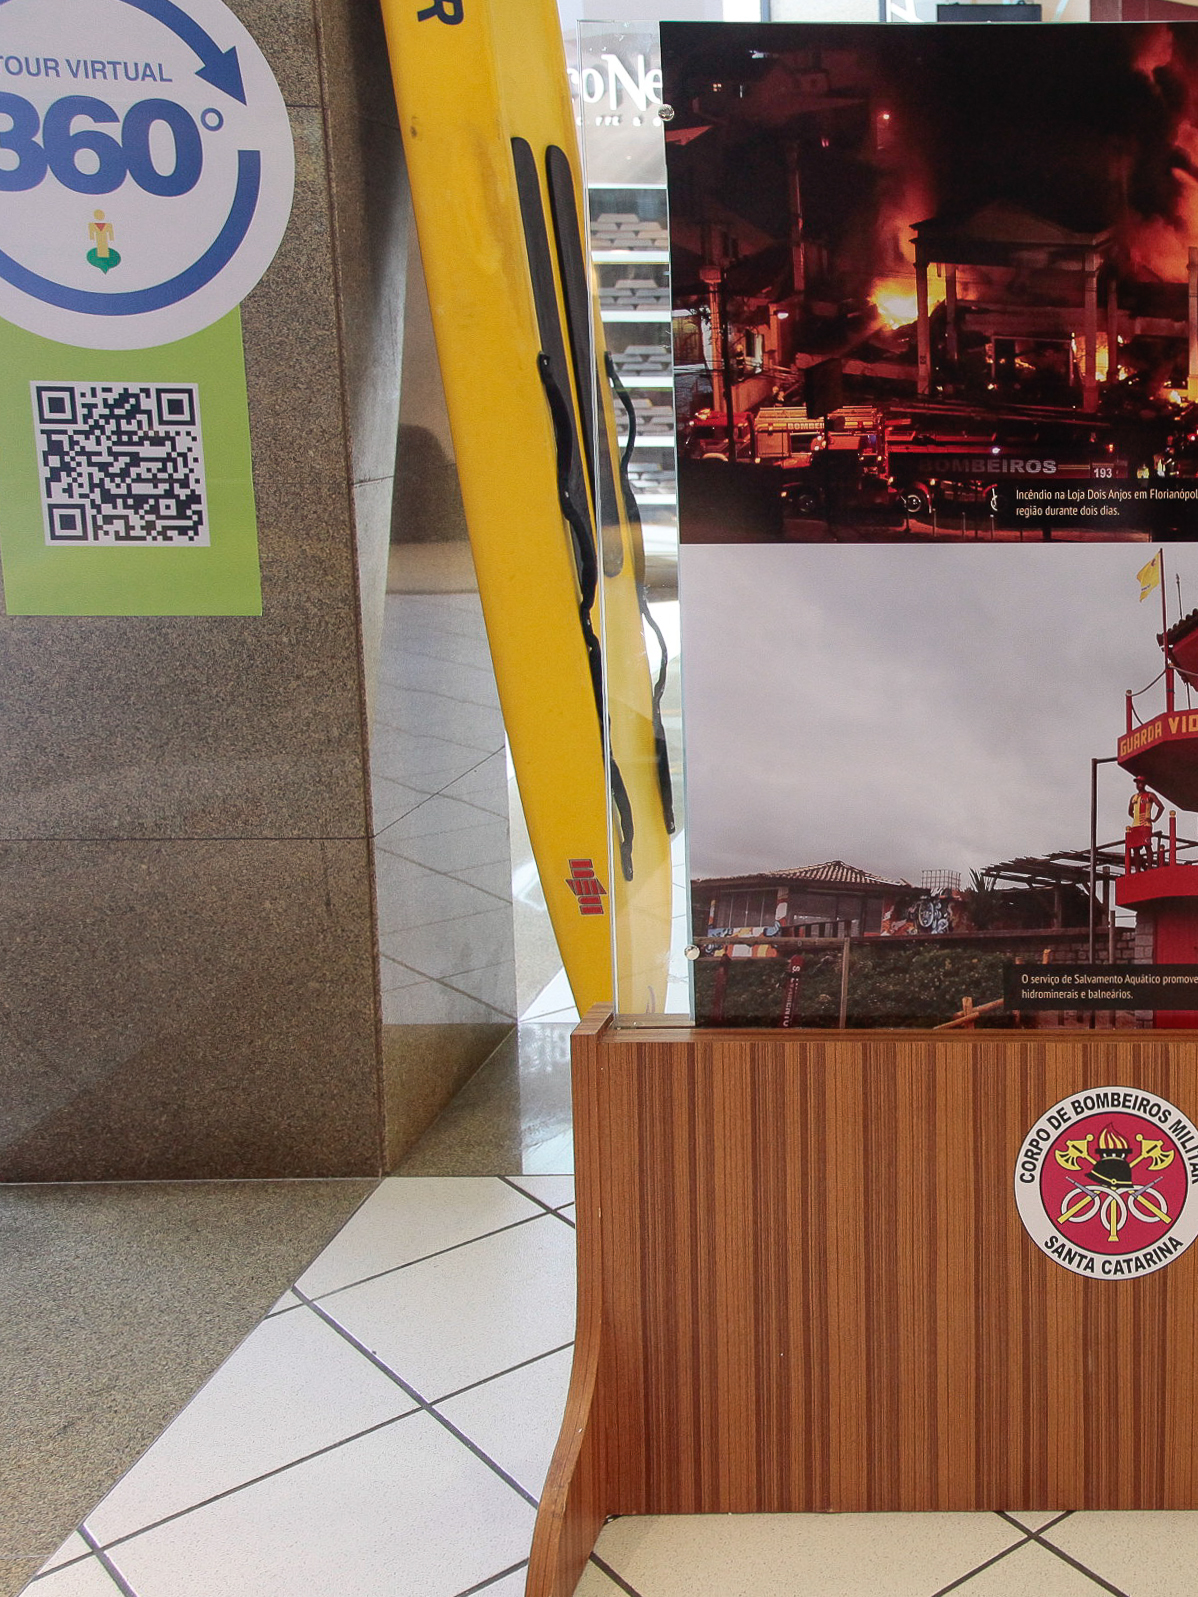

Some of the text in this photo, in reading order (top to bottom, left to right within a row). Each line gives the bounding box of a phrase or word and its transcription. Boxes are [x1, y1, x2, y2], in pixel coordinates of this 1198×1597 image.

[65, 58, 173, 82] VIRTUAL
[788, 422, 825, 430] BOMBEI
[919, 458, 1113, 478] BOMBEIROS 193
[1016, 489, 1052, 500] Incêndio
[1054, 491, 1065, 500] na
[1067, 489, 1085, 502] Loja
[1087, 489, 1106, 500] Dois
[1108, 489, 1131, 502] Anjos
[1134, 491, 1147, 500] em
[1016, 505, 1120, 518] região durante dois dias.
[1120, 720, 1162, 757] GUARDA
[1021, 974, 1029, 984] O
[1030, 974, 1060, 986] serviço
[1062, 974, 1072, 984] de
[1074, 974, 1123, 984] Salvamento
[1124, 974, 1160, 986] Aquático
[1162, 976, 1198, 986] promove
[1021, 989, 1133, 1000] hidrominerais e balneários.
[1019, 1127, 1051, 1184] CORPO
[1046, 1106, 1072, 1131] DE
[1070, 1092, 1172, 1125] BOMBEIROS
[1044, 1235, 1184, 1275] SANTA CATARINA
